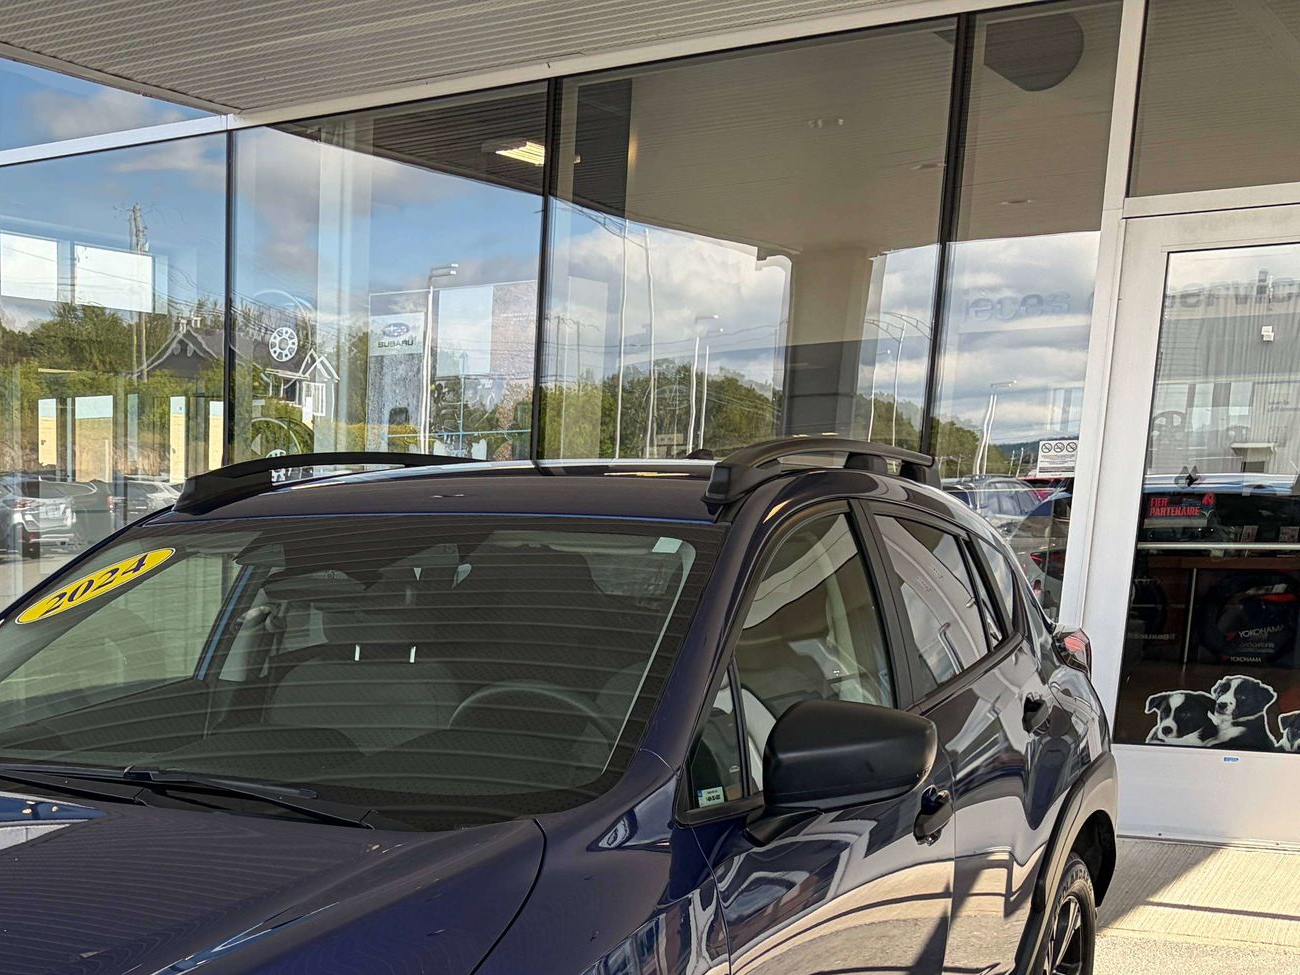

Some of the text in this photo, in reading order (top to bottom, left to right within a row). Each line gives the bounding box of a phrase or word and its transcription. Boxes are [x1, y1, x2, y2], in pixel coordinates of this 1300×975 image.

[377, 339, 414, 348] SUBARU
[1150, 496, 1169, 507] FIER
[1149, 506, 1201, 517] PARTENAIRE
[38, 553, 149, 617] 2024
